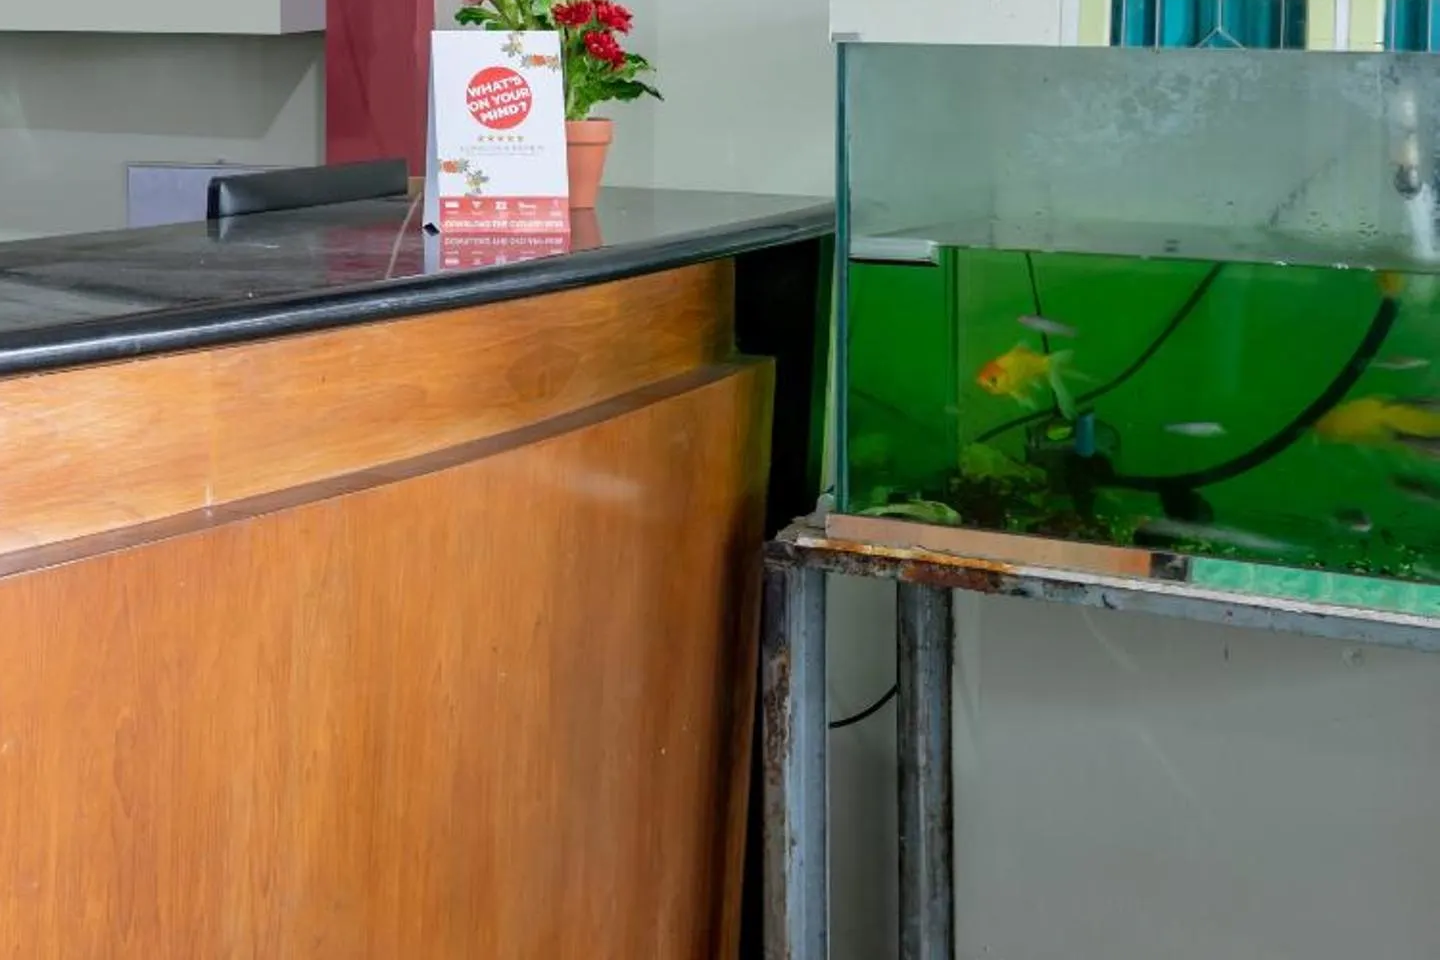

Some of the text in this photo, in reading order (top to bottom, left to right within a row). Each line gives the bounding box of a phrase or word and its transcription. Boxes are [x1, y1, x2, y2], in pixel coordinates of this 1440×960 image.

[467, 75, 523, 97] WHAT'S
[470, 86, 531, 113] ON YOUR
[479, 101, 527, 122] MIND?
